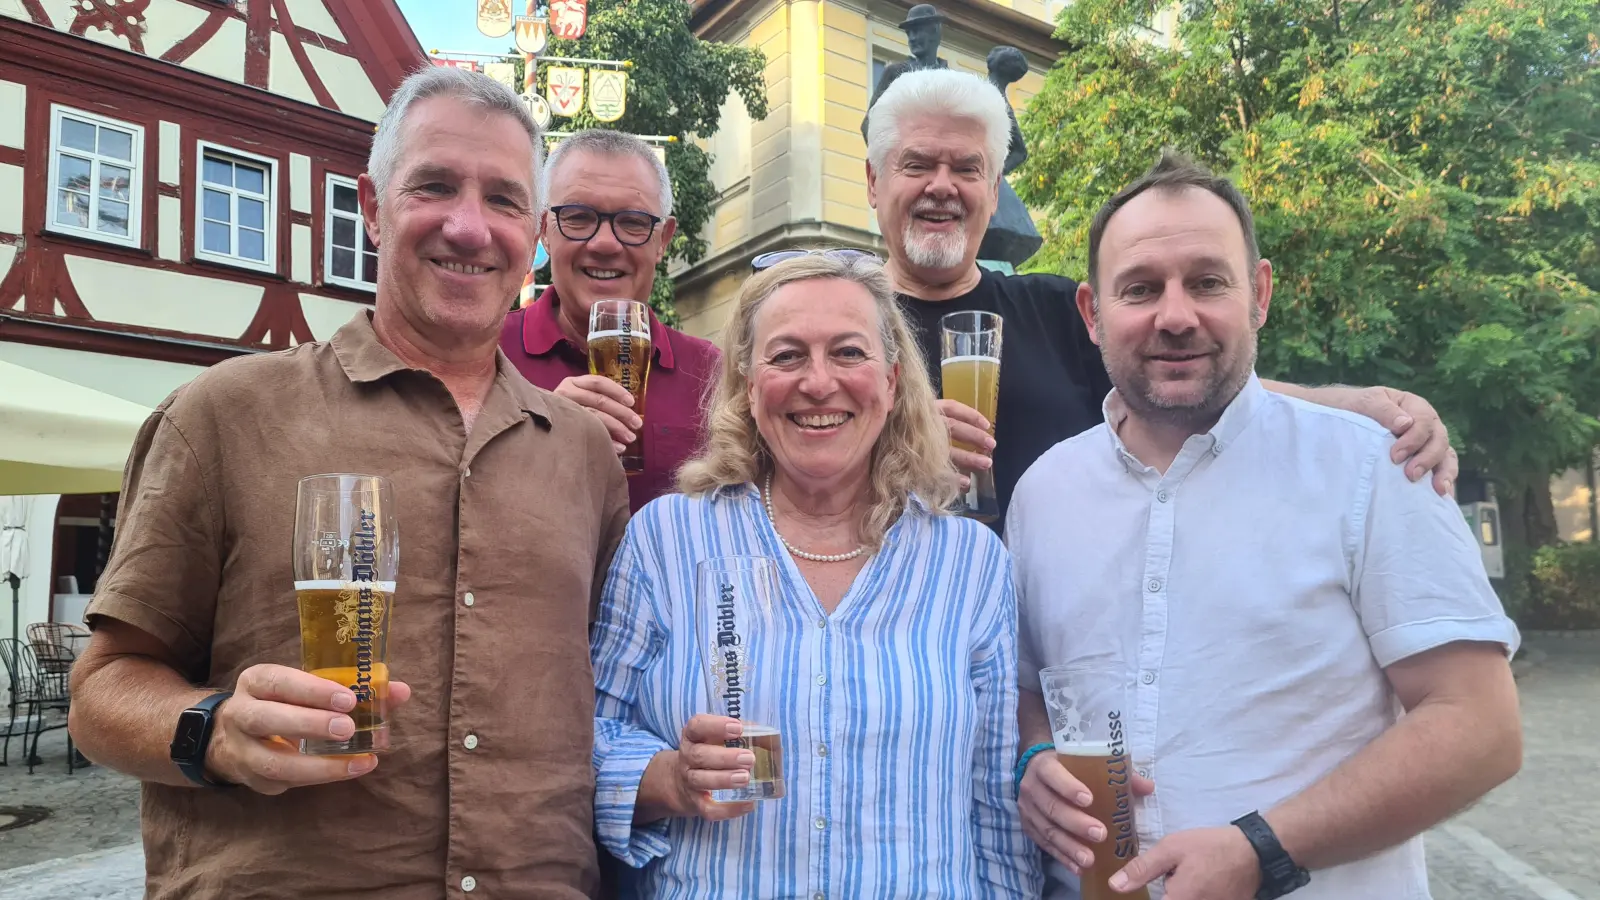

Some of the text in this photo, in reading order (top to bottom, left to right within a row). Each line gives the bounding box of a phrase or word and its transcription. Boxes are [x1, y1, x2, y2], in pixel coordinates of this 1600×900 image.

[350, 508, 379, 702] Brauhaus Döbler
[717, 583, 741, 647] Döbler
[1106, 709, 1128, 786] Weisse
